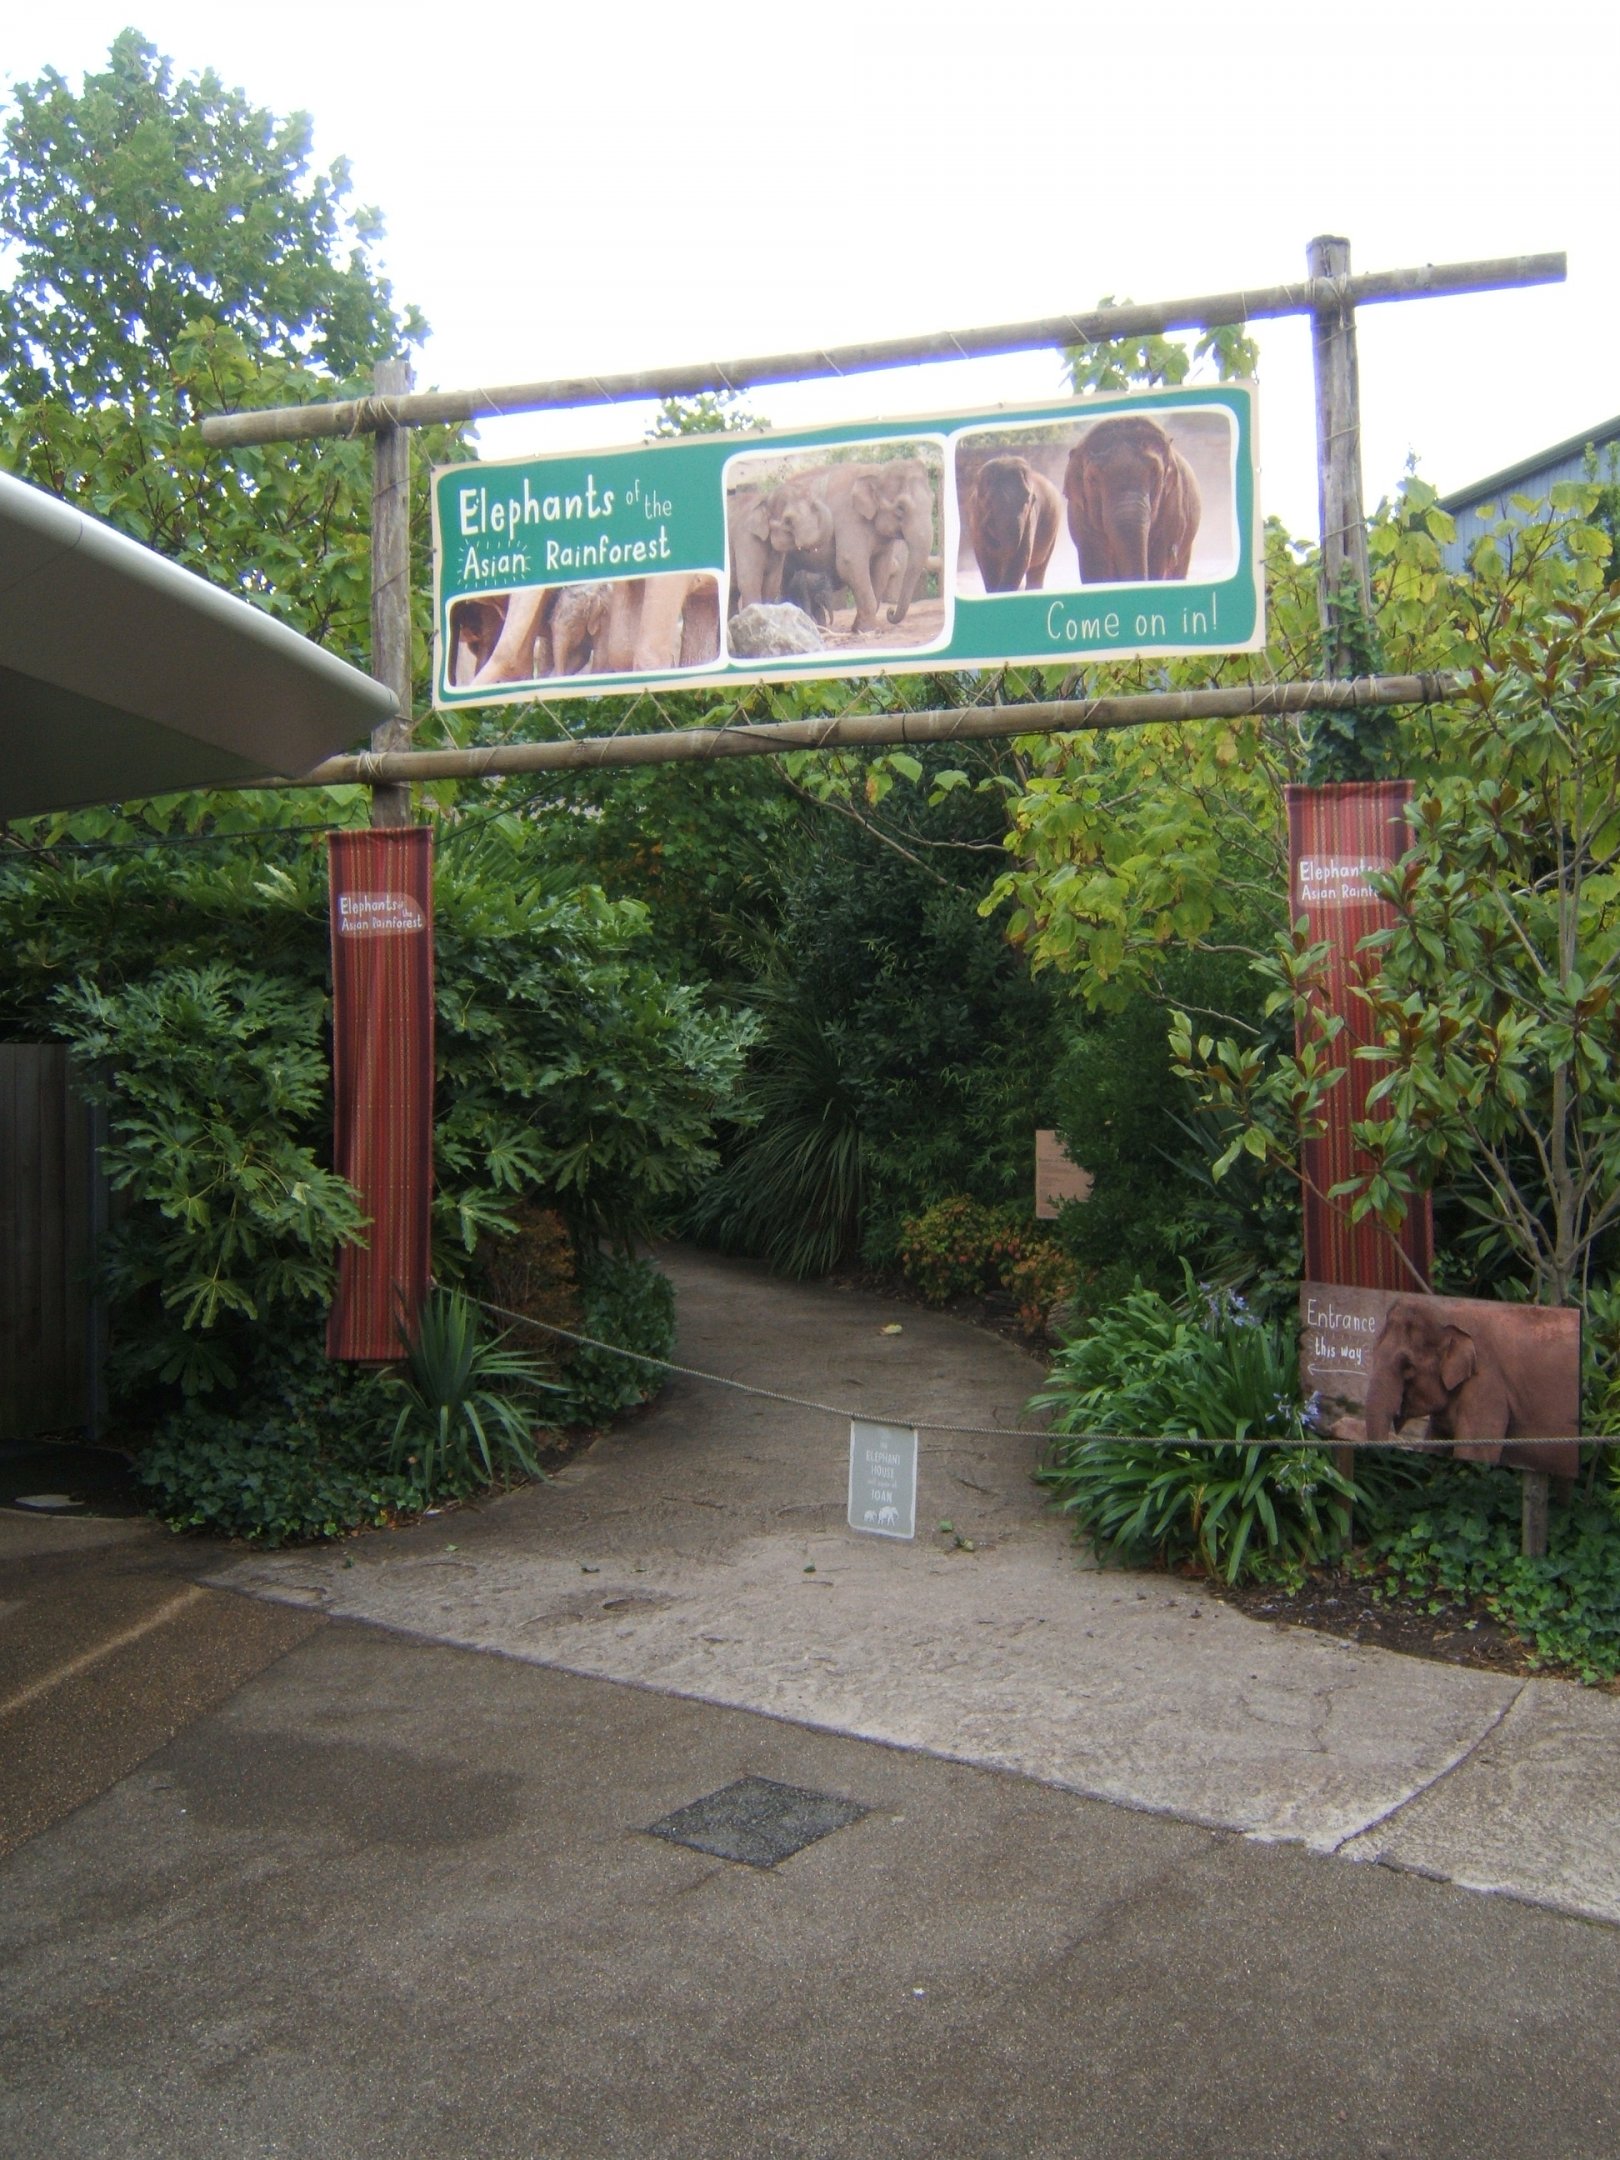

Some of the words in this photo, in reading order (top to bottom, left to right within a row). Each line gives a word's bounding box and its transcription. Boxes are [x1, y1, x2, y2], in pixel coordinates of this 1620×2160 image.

[459, 474, 614, 540] Elephants
[626, 479, 640, 505] of
[645, 490, 672, 520] the
[463, 545, 525, 580] Asian
[546, 525, 671, 570] Rainforest
[1047, 601, 1119, 640] Come
[1135, 613, 1166, 637] on
[1182, 591, 1217, 634] in!
[340, 895, 398, 917] Elephants
[1302, 885, 1336, 900] Asian
[341, 917, 368, 931] Asian
[372, 914, 422, 929] Rainforest
[1307, 1299, 1375, 1332] Entrance
[1315, 1336, 1335, 1357] this
[1341, 1346, 1361, 1365] way
